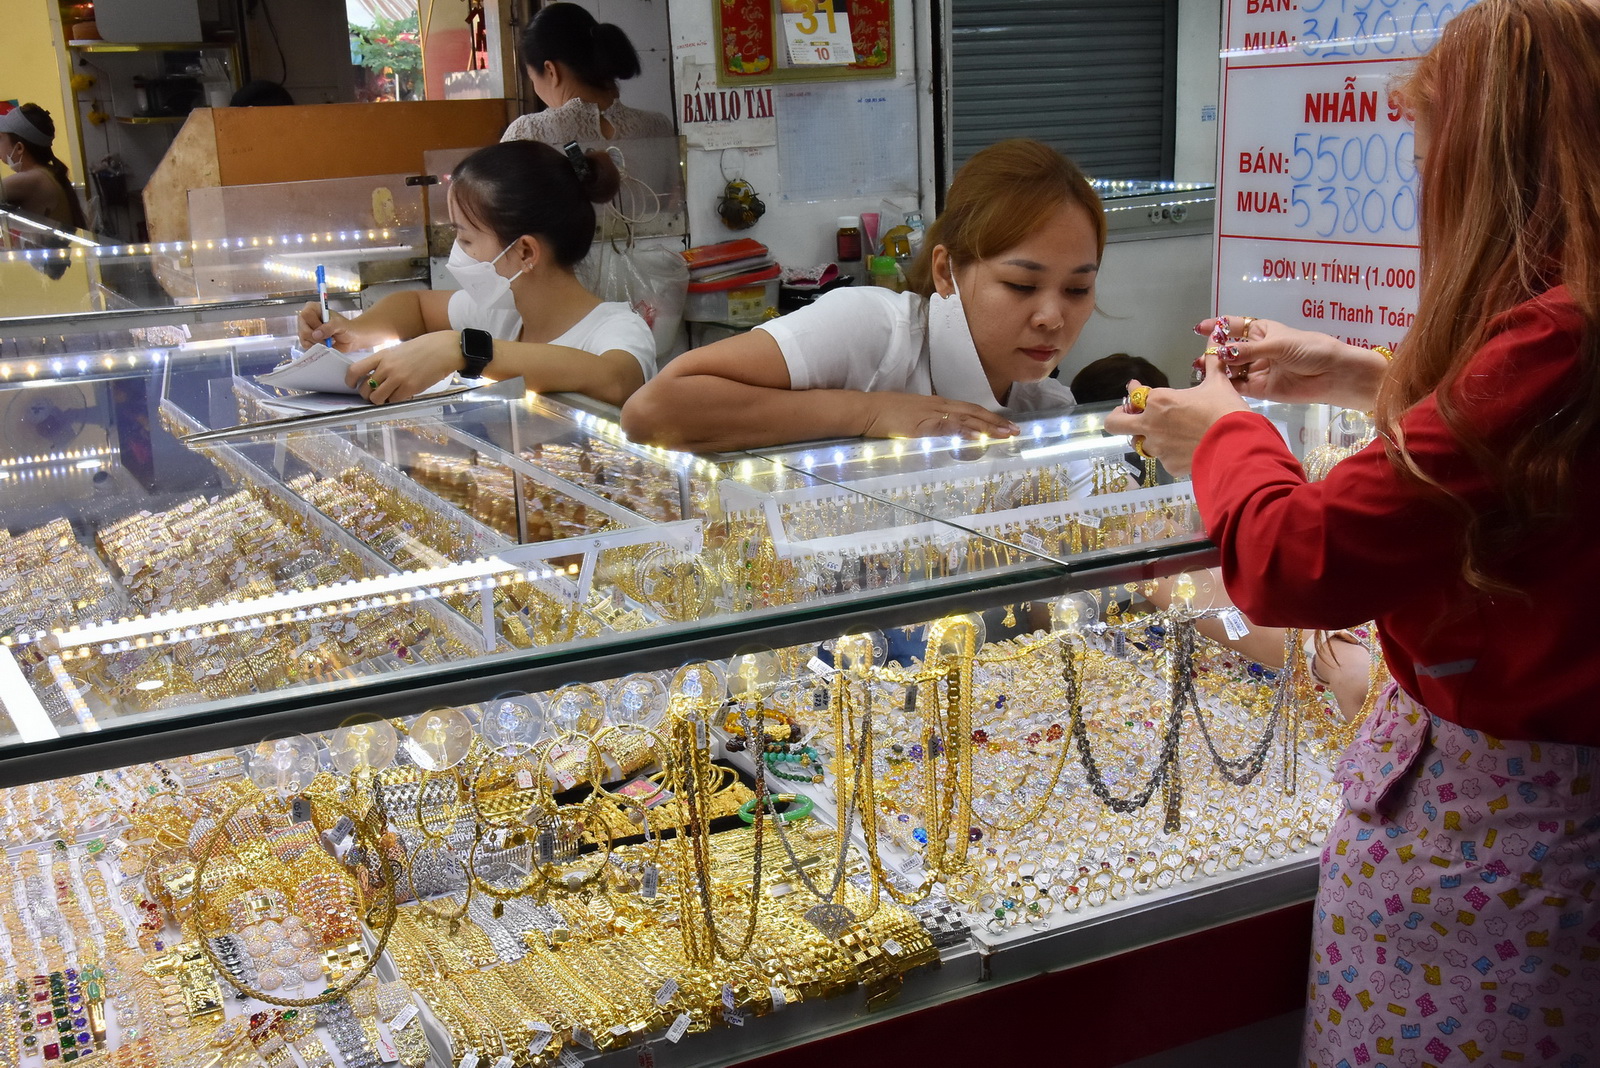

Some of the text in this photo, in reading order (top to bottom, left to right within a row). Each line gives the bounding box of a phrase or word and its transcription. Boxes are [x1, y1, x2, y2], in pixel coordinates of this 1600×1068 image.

[795, 0, 837, 35] 31
[814, 47, 831, 61] 10
[1244, 30, 1297, 53] MUA:
[683, 72, 718, 123] BẤM
[743, 87, 775, 119] TAI
[1304, 76, 1378, 123] NHẪN
[1239, 146, 1290, 174] BÁN:
[1236, 191, 1288, 214] MUA:
[1262, 257, 1416, 291] ĐƠN VỊ TÍNH (1.000
[1302, 298, 1416, 328] Giá Thanh Toán
